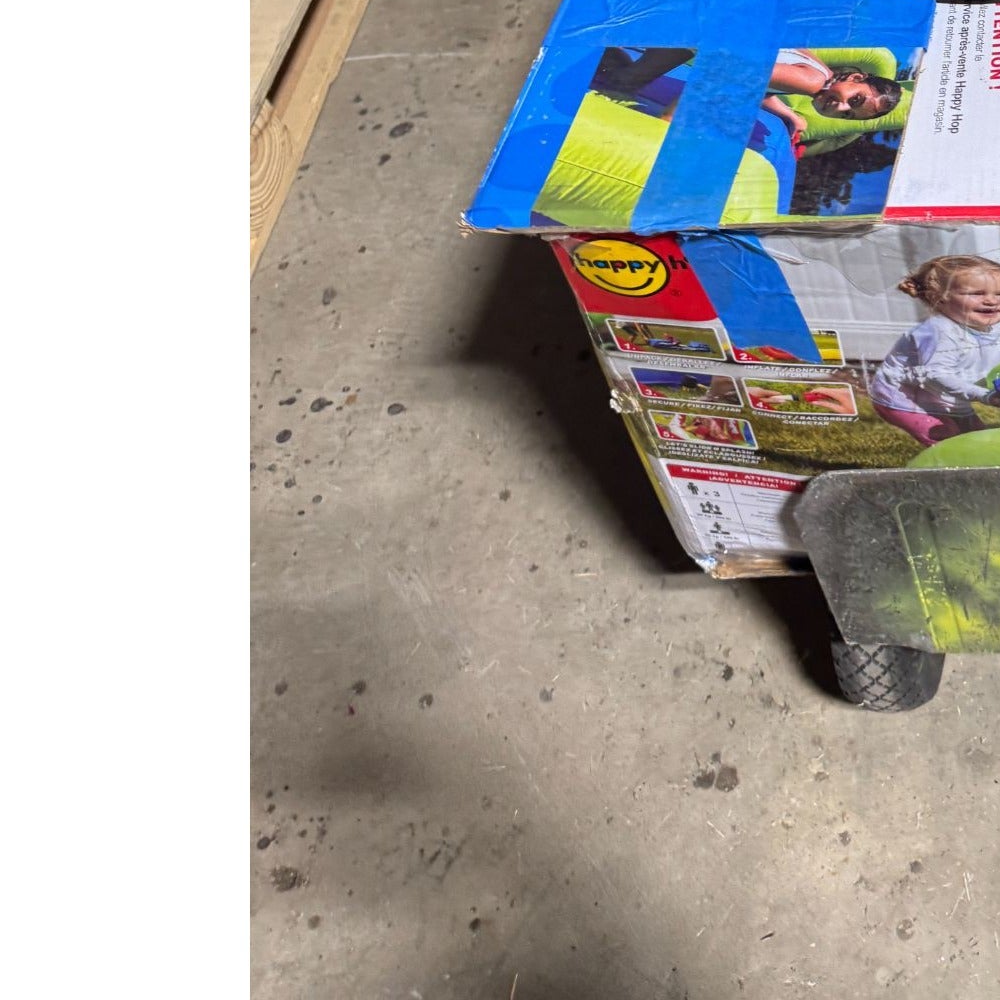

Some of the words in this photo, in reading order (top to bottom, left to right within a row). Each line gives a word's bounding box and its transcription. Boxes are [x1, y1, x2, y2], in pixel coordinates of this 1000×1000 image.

[947, 16, 956, 25] de
[961, 3, 972, 24] rvice
[943, 26, 954, 58] retourner
[956, 26, 971, 78] après-vente
[938, 87, 947, 97] en
[951, 81, 966, 111] Happy
[948, 114, 963, 134] Hop
[575, 253, 660, 273] happy
[740, 353, 752, 361] 2.
